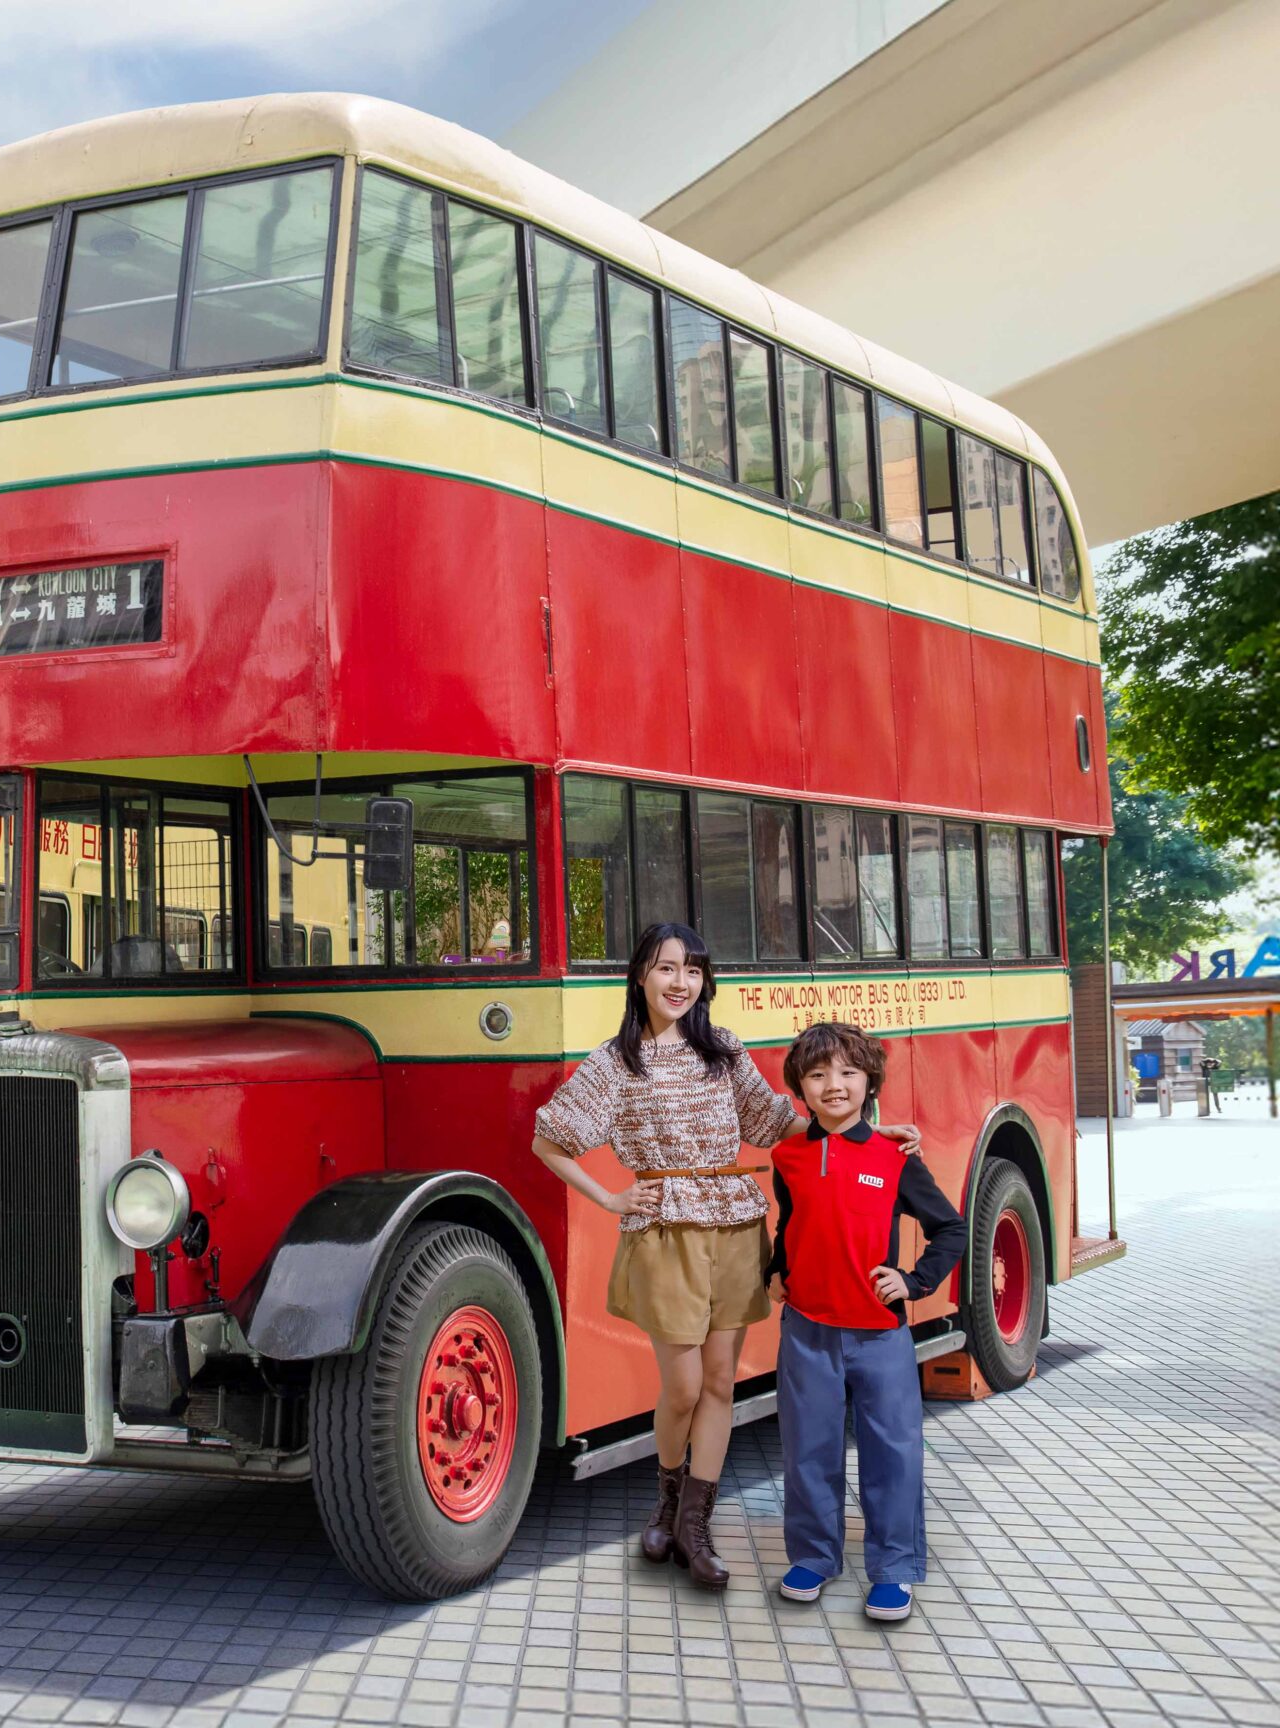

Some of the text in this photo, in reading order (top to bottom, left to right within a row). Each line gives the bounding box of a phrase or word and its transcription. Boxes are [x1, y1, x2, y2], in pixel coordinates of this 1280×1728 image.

[38, 569, 87, 597] KOWLOON
[92, 566, 117, 591] CITY
[126, 568, 144, 610] 1
[37, 593, 117, 622] 九龍城
[739, 987, 764, 1011] THE
[770, 986, 823, 1009] KOWLOON
[828, 983, 863, 1006] MOTOR
[869, 983, 889, 1005] BUS
[948, 980, 968, 1001] LTD.
